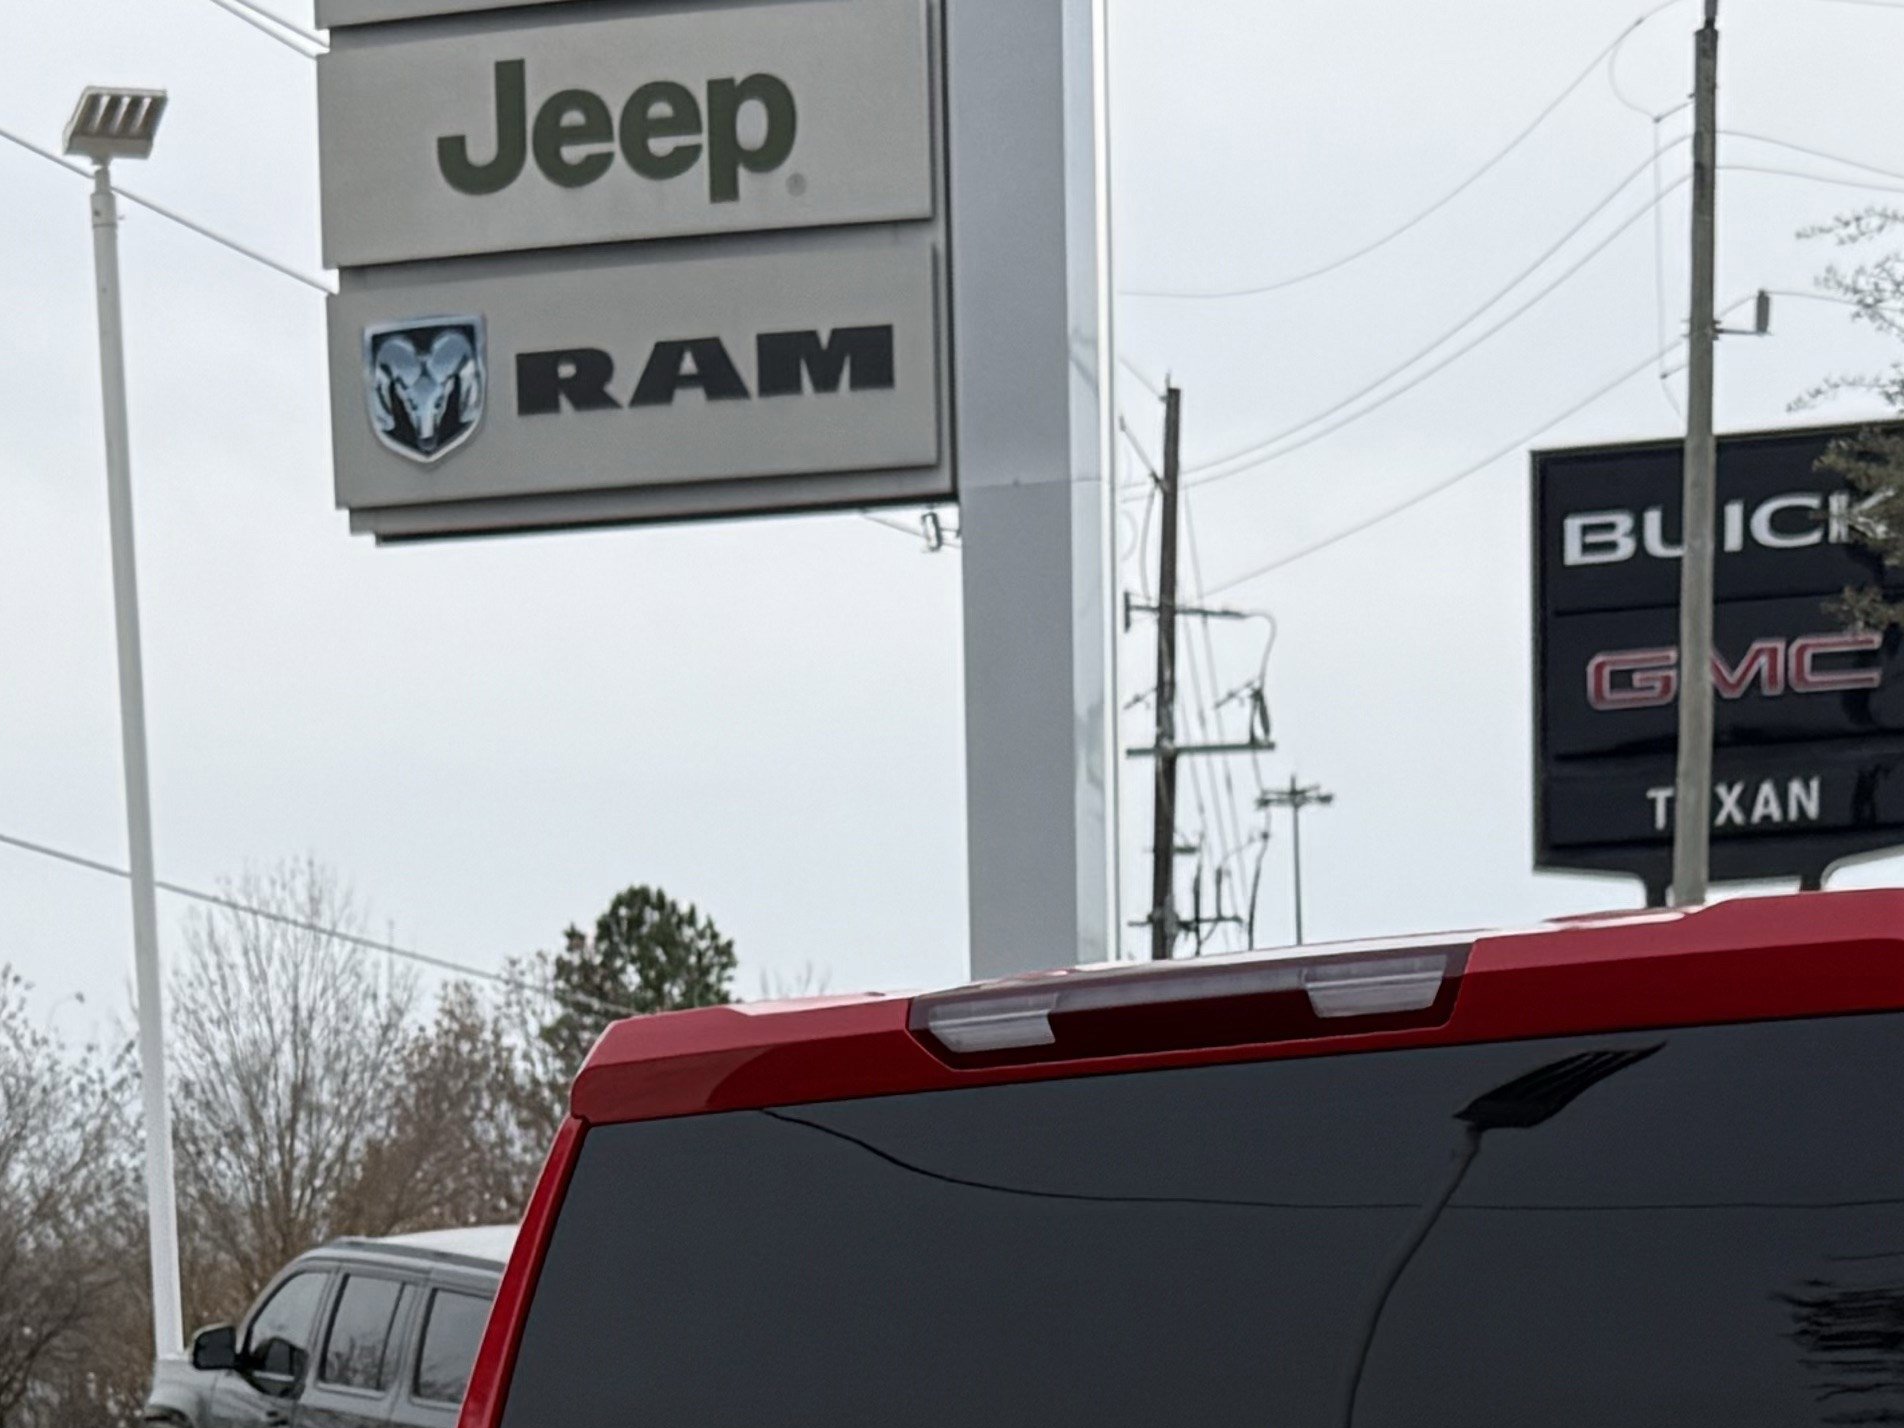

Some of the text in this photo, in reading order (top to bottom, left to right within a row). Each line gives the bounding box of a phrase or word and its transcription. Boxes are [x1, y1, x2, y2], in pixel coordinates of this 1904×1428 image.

[437, 58, 798, 203] Jeep
[516, 324, 894, 416] RAM
[1586, 631, 1883, 711] GMC
[1647, 776, 1821, 830] TXAN
